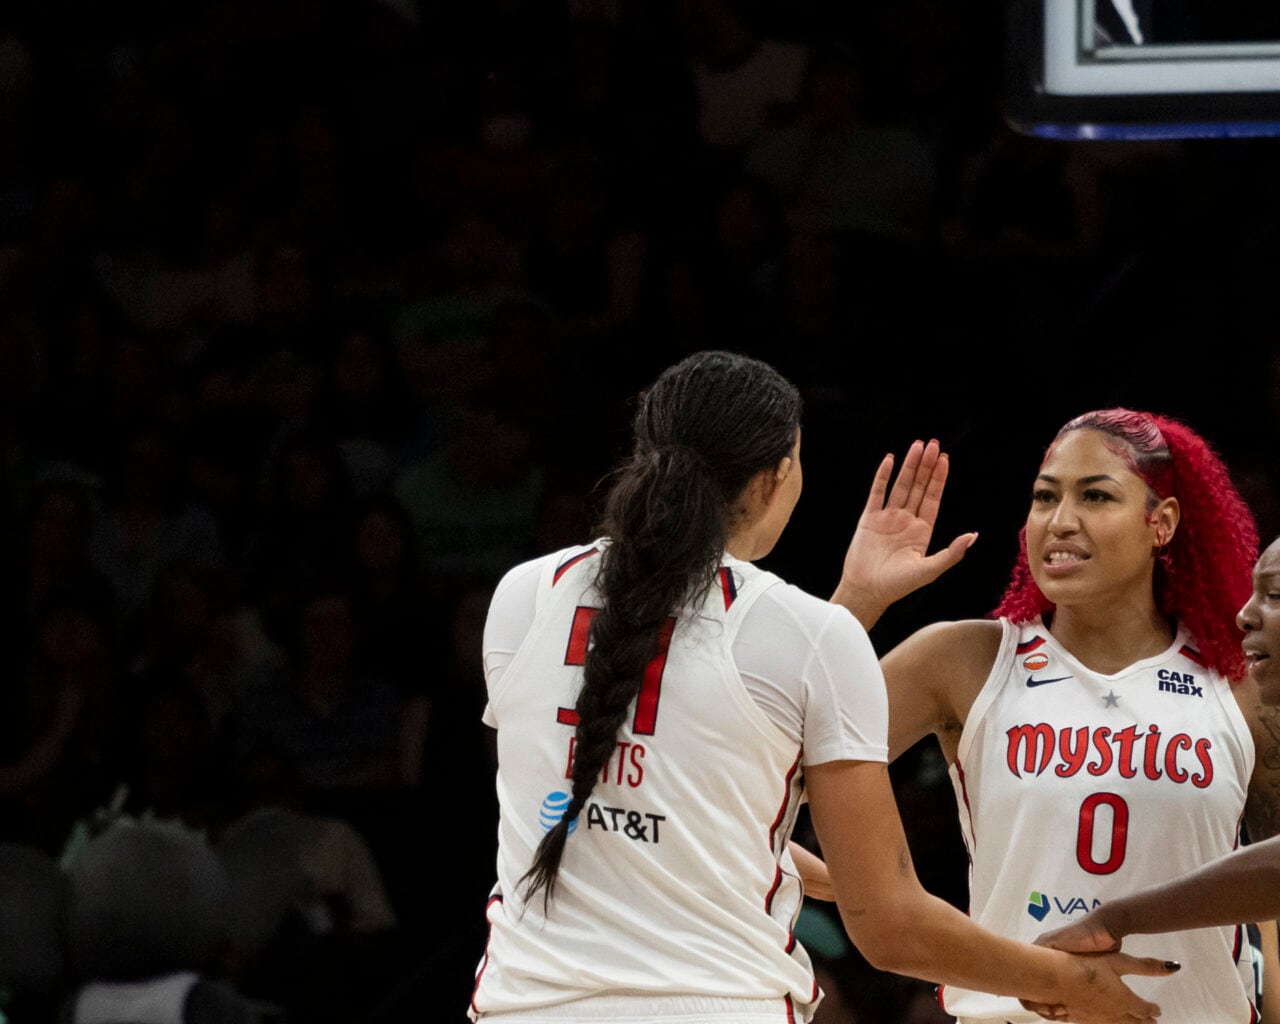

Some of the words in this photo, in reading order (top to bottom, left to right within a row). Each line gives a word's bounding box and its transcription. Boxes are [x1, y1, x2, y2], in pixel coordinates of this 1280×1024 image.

[1157, 669, 1195, 685] CAR
[1158, 680, 1203, 698] max
[587, 803, 666, 844] AT&T
[1076, 792, 1129, 875] 0
